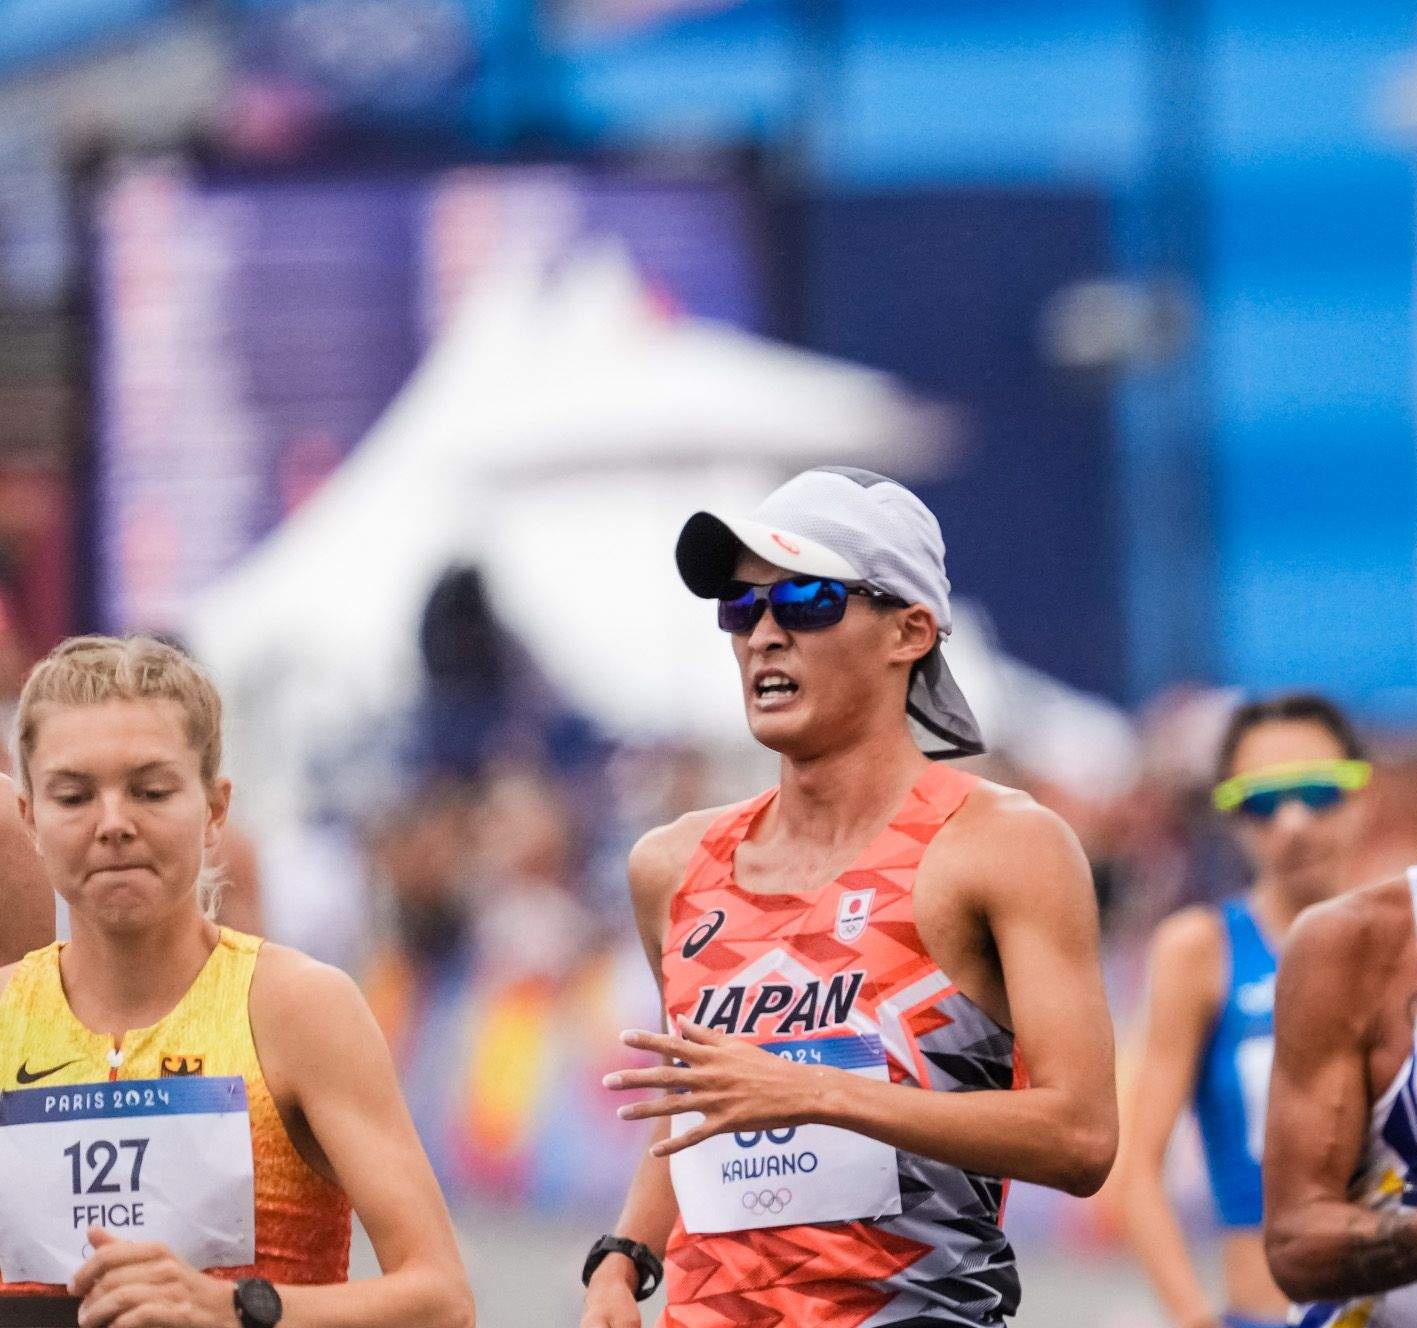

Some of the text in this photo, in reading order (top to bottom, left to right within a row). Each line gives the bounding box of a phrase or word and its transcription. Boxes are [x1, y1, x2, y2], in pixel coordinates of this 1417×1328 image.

[45, 1088, 170, 1113] PARIS 2024
[63, 1137, 150, 1195] 127
[721, 1151, 818, 1185] KAWANO
